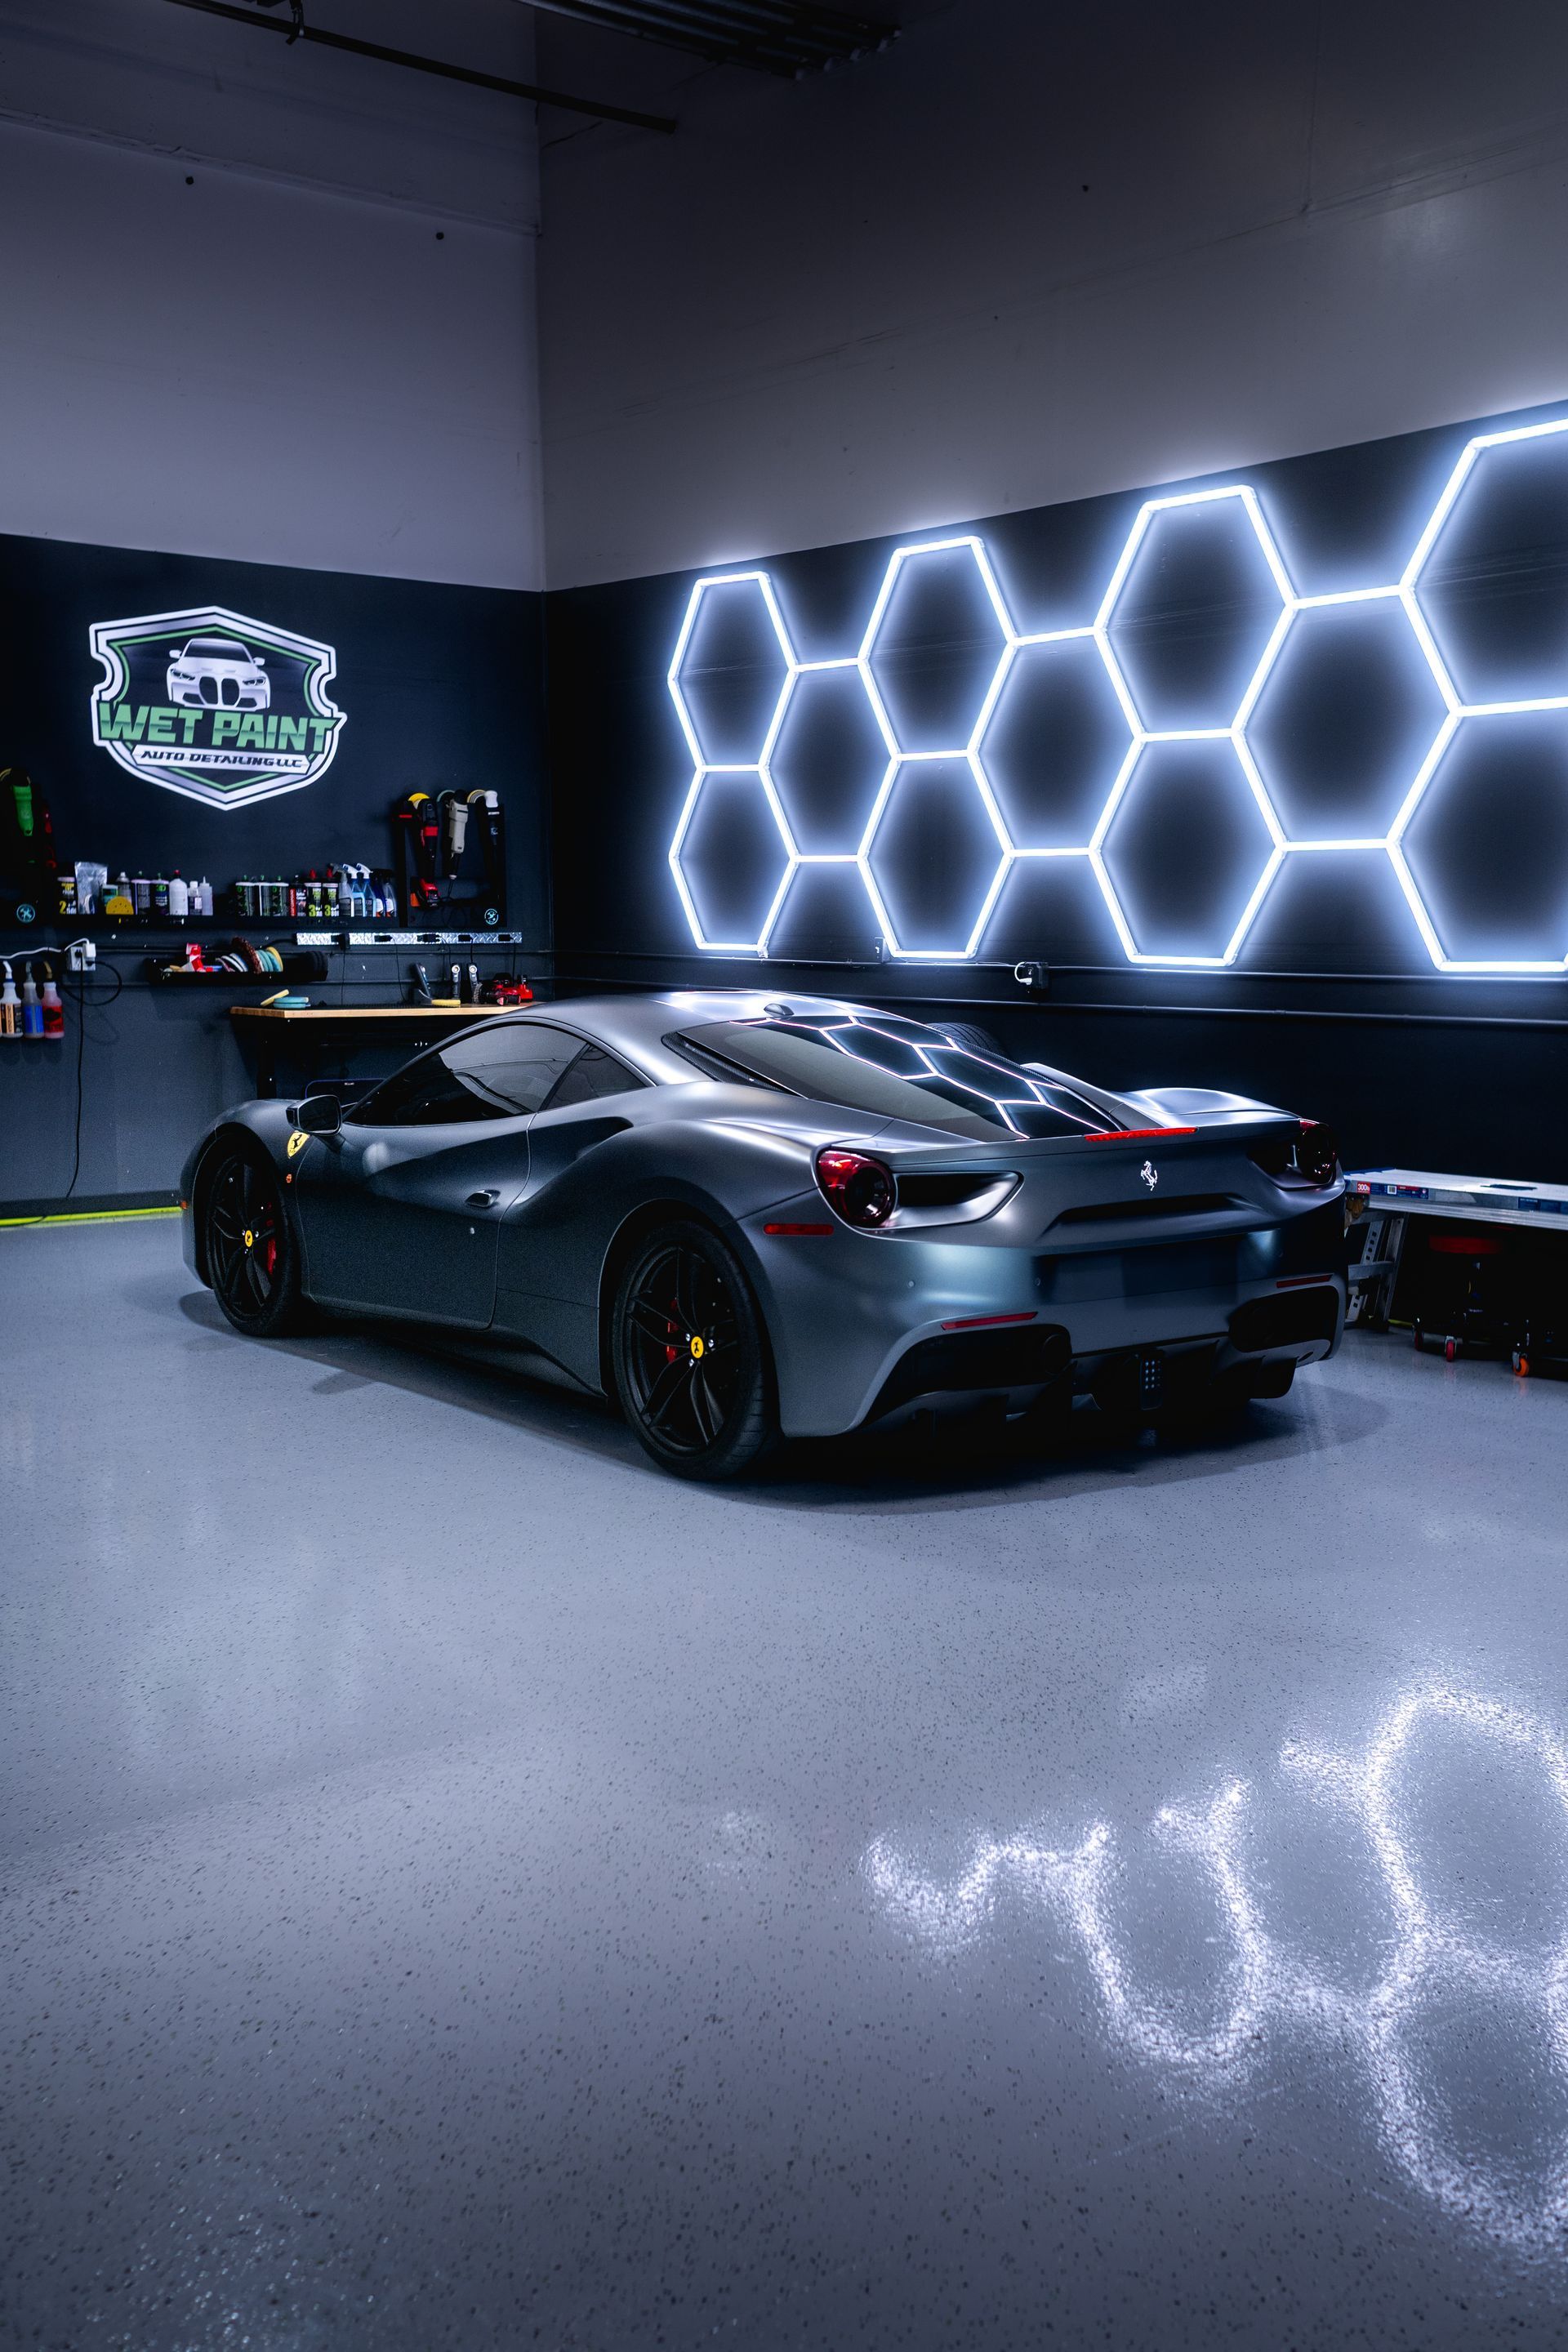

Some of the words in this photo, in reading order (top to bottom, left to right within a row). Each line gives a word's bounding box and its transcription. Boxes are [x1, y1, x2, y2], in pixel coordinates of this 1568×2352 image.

[99, 702, 203, 744] WET
[212, 711, 337, 753] PAINT
[141, 751, 184, 761] AUTO
[189, 754, 274, 766] DETAILING
[276, 759, 302, 768] LLC
